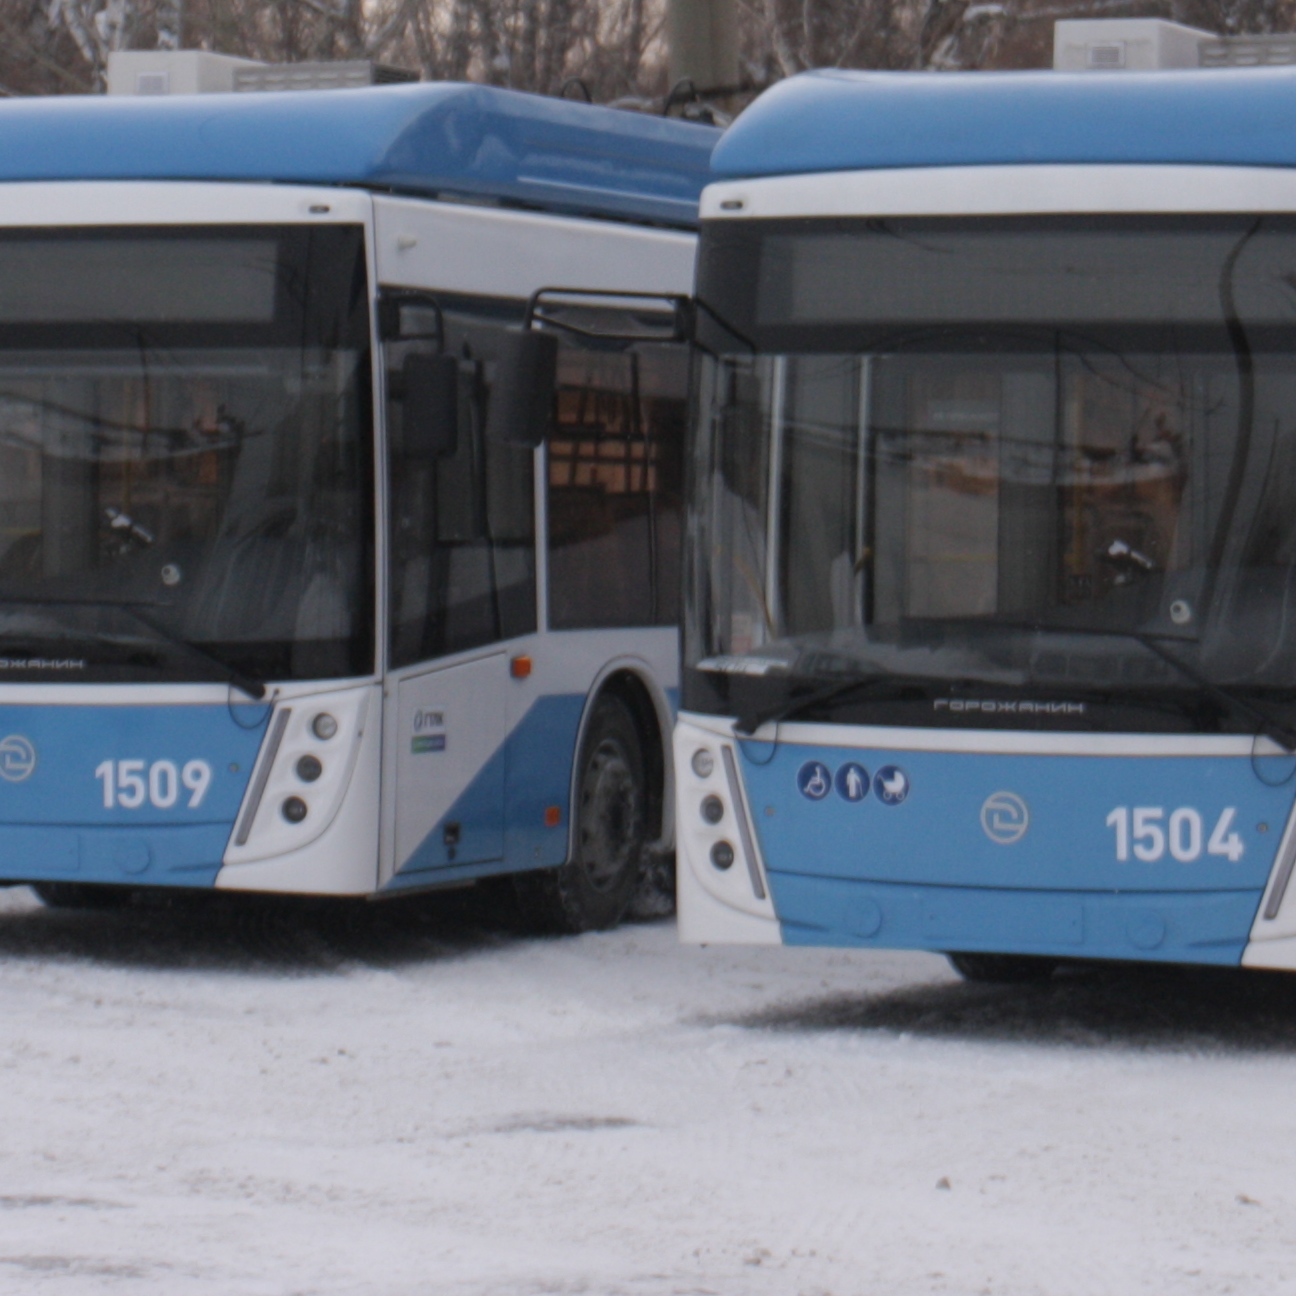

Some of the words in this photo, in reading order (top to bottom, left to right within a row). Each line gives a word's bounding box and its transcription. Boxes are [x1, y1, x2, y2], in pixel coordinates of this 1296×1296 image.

[933, 699, 1084, 714] ГОРОЖАНИН
[95, 759, 211, 808] 1509
[1106, 806, 1244, 862] 1504
